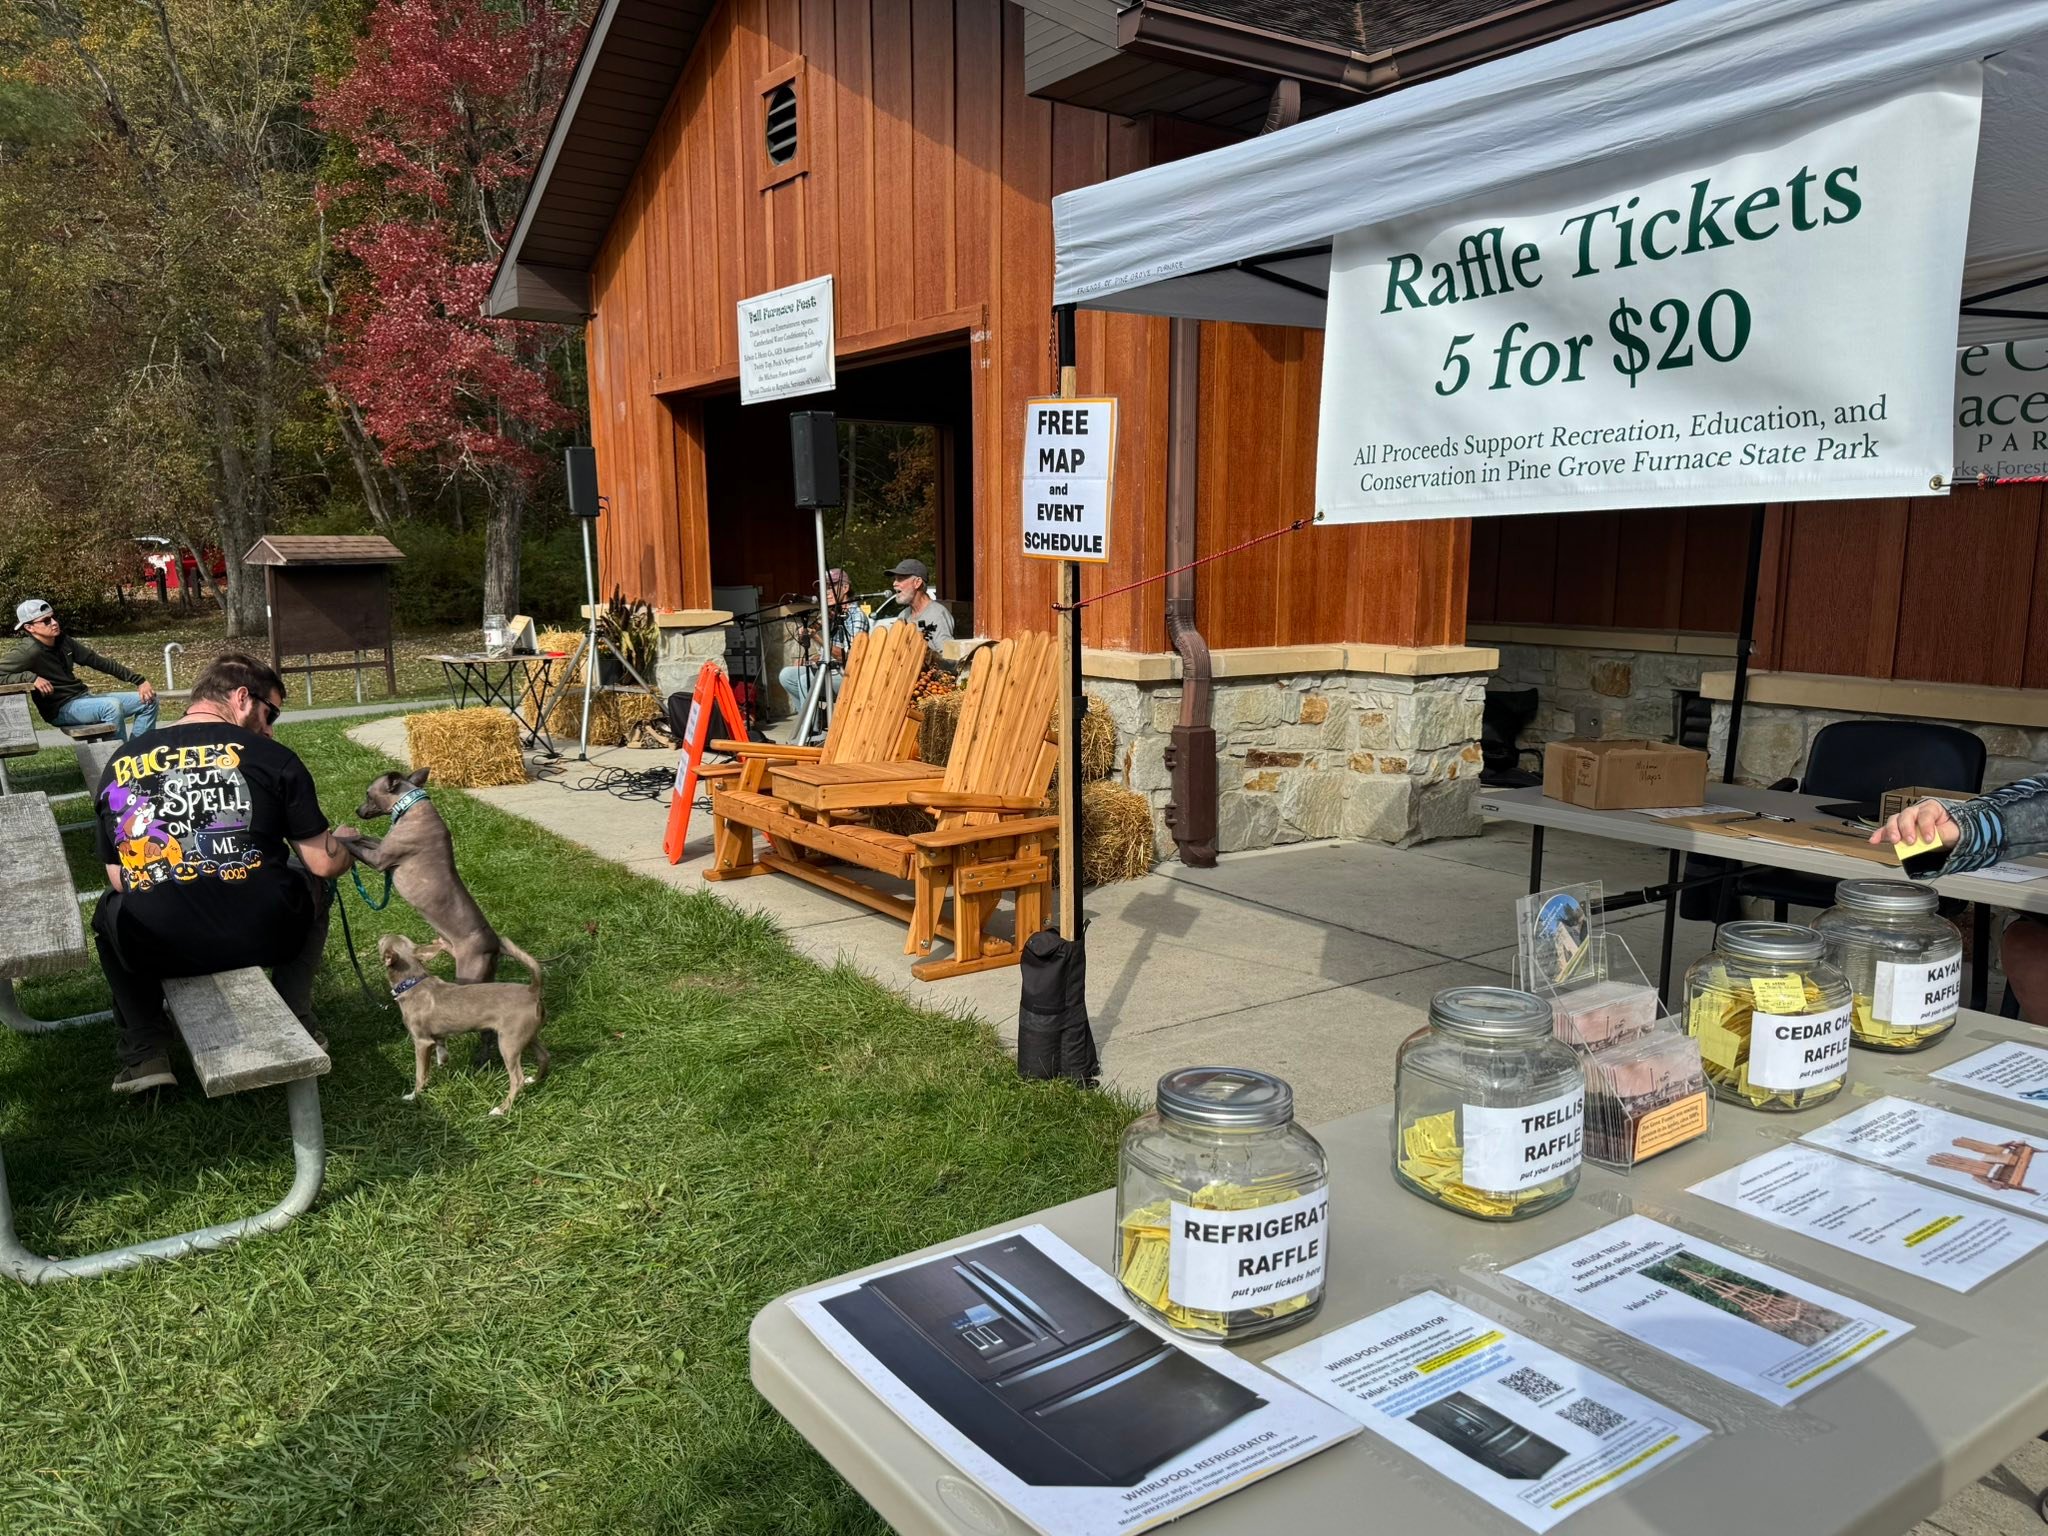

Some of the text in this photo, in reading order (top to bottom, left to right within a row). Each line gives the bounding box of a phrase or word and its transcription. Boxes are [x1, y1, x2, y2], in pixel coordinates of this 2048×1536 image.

[1381, 164, 1862, 314] Raffle Tickets
[796, 296, 816, 312] Fest
[1434, 288, 1751, 397] 5 for $20
[1038, 410, 1088, 435] FREE
[1354, 394, 1888, 466] All Proceeds Support Recreation, Education, and
[1040, 448, 1085, 472] MAP
[1360, 433, 1879, 492] Conservation in Pine Grove Furnace State Park
[1983, 464, 1993, 475] &
[1049, 483, 1068, 495] and
[1038, 504, 1084, 522] EVENT
[1025, 532, 1102, 553] SCHEDULE
[112, 743, 244, 787] BUC-EE'S
[187, 769, 240, 789] PUT A
[168, 820, 195, 836] ON
[212, 836, 239, 855] ME
[219, 868, 247, 881] 2025
[1925, 981, 1959, 1005] RAFFLE
[1776, 1021, 1831, 1040] CEDAR
[1804, 1037, 1847, 1063] RAFFLE
[1799, 1070, 1810, 1079] put
[1811, 1068, 1824, 1076] your
[1522, 1098, 1582, 1133] TRELLIS
[1525, 1127, 1580, 1162] RAFFLE
[1520, 1170, 1533, 1181] put
[1534, 1166, 1550, 1177] your
[1551, 1157, 1571, 1170] tickets
[1184, 1200, 1328, 1244] REFRIGERAT
[1238, 1239, 1318, 1278] RAFFLE
[1572, 1241, 1631, 1267] OBELISK TRELLIS
[1614, 1250, 1640, 1264] obelisk
[1574, 1242, 1685, 1293] handmade with treated lumber
[1231, 1266, 1321, 1299] put your tickets here
[1623, 1297, 1650, 1310] Value
[1325, 1345, 1384, 1371] WHIRLPOOL
[1383, 1316, 1448, 1349] REFRIGERATOR
[1391, 1370, 1420, 1388] $1999
[1122, 1432, 1278, 1501] WHIRLPOOL REFRIGERATOR
[1123, 1499, 1151, 1515] French
[1189, 1467, 1224, 1485] ice-maker
[1225, 1460, 1241, 1469] with
[1240, 1449, 1266, 1463] exterior
[1265, 1434, 1298, 1452] dispenser
[1117, 1512, 1142, 1525] Model
[1269, 1447, 1288, 1458] black
